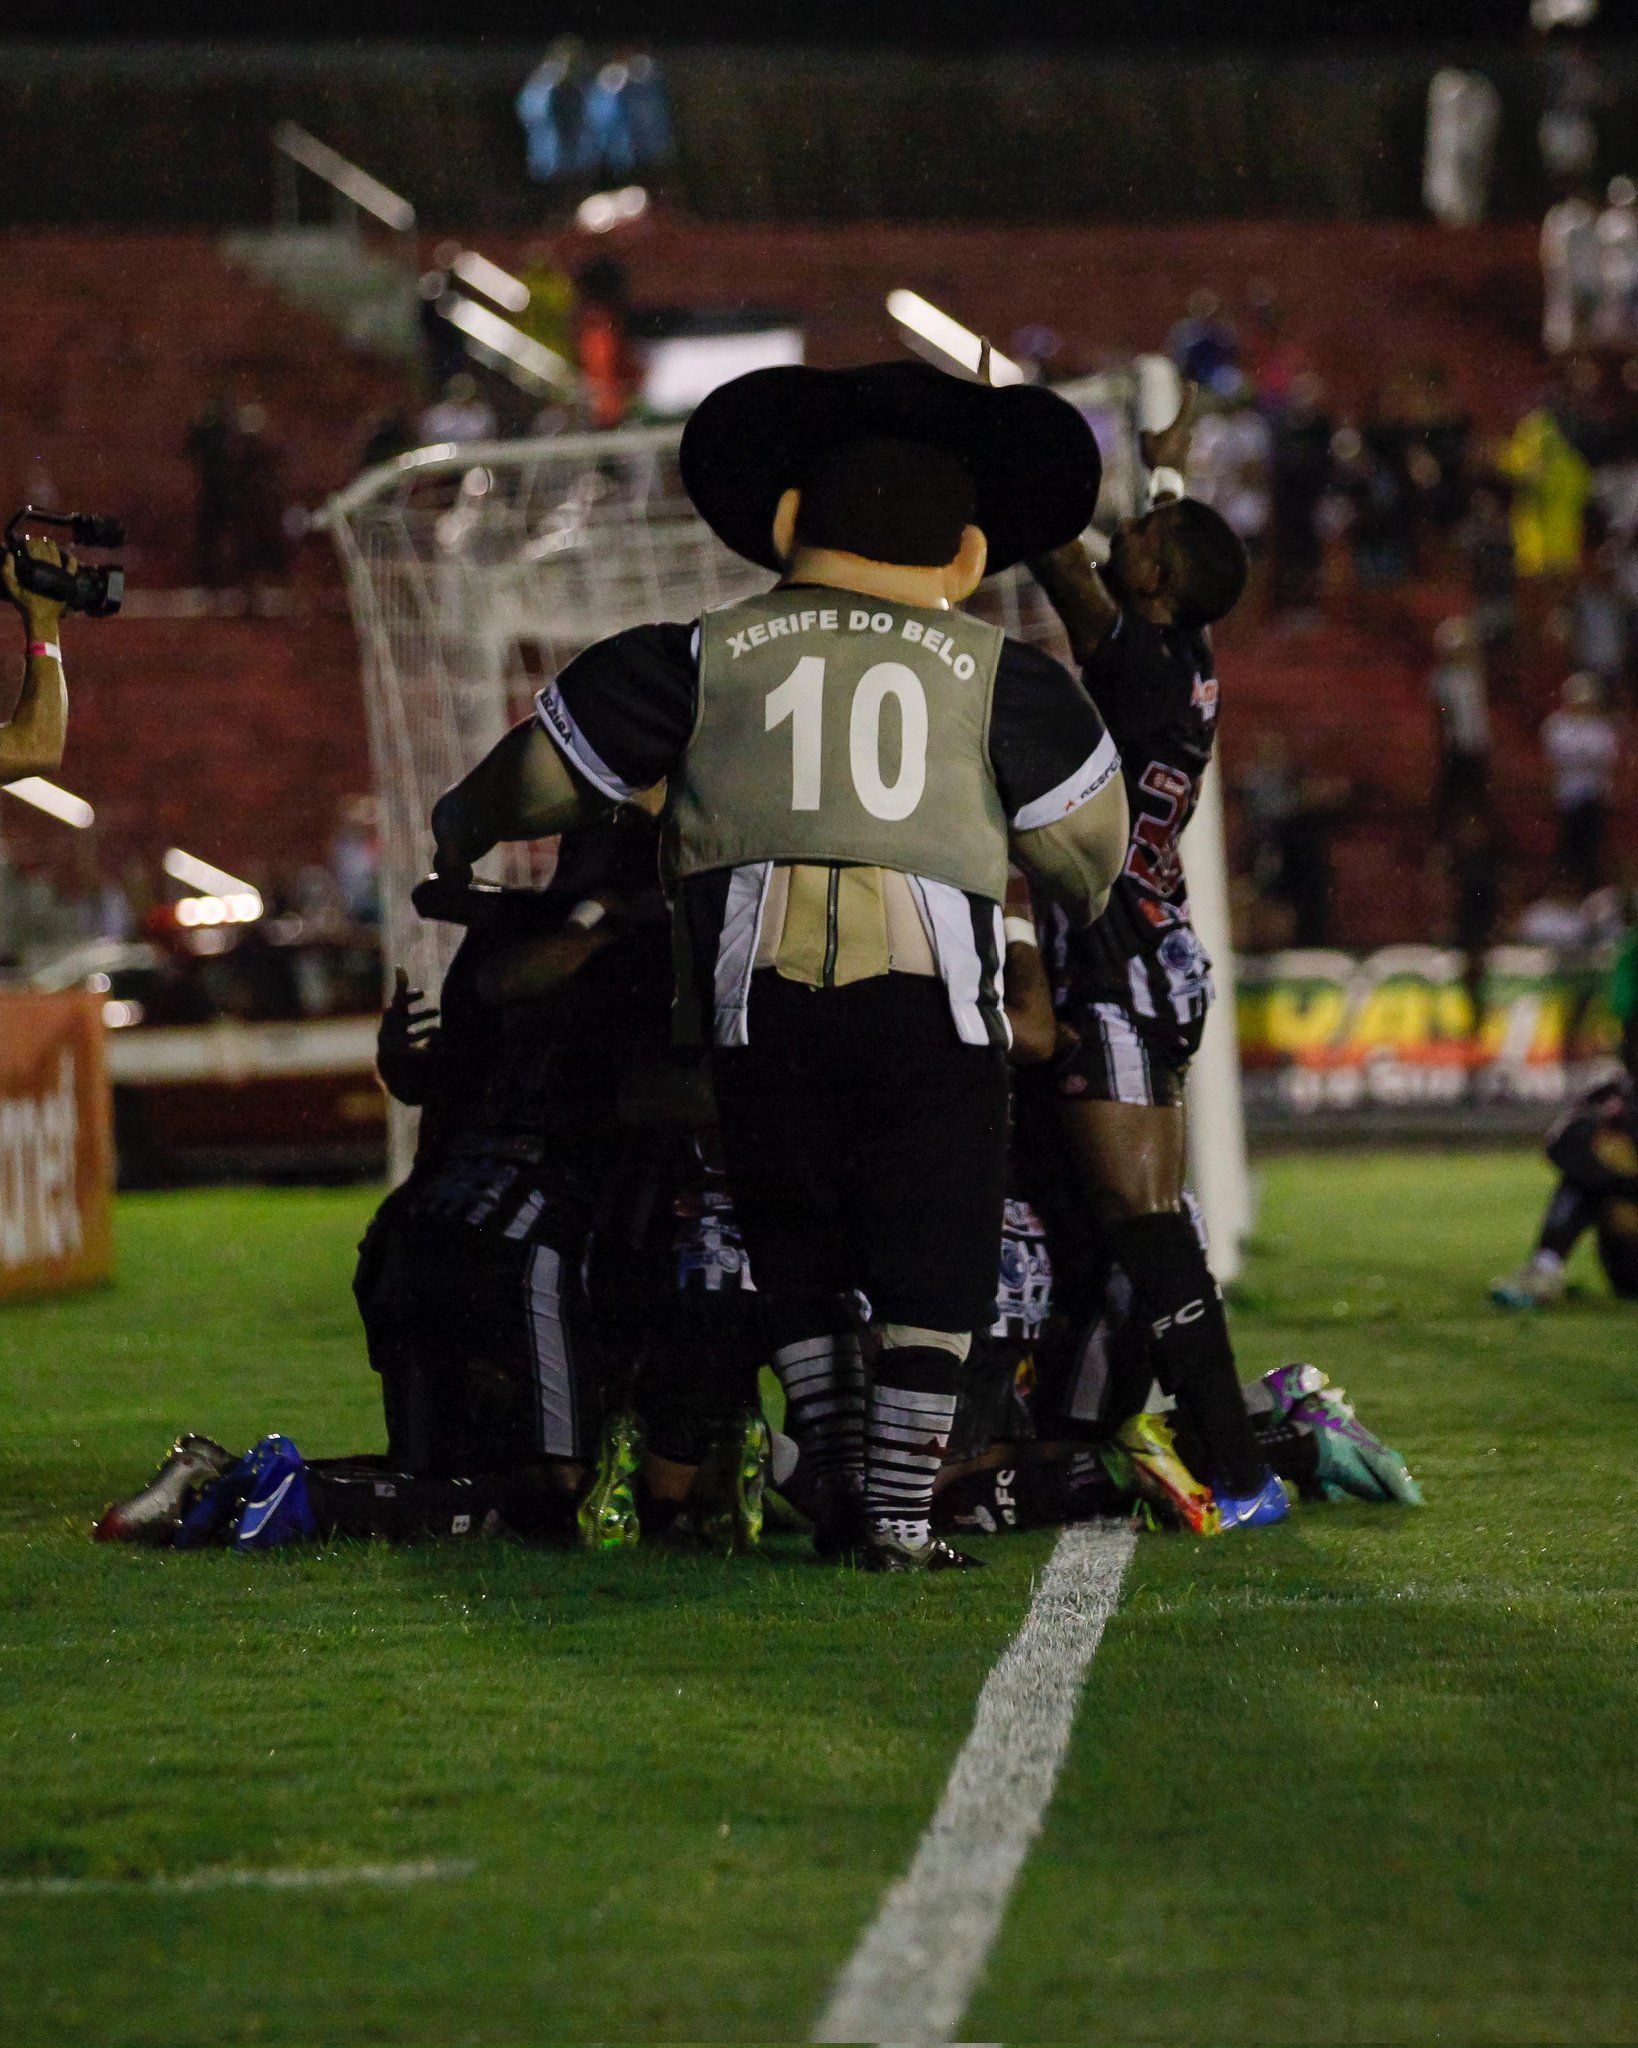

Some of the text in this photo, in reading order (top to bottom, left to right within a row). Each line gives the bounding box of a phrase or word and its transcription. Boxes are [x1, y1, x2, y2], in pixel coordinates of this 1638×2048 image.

[726, 609, 976, 681] XERIFE DO BELO
[765, 656, 929, 822] 10
[1152, 1298, 1205, 1340] FC
